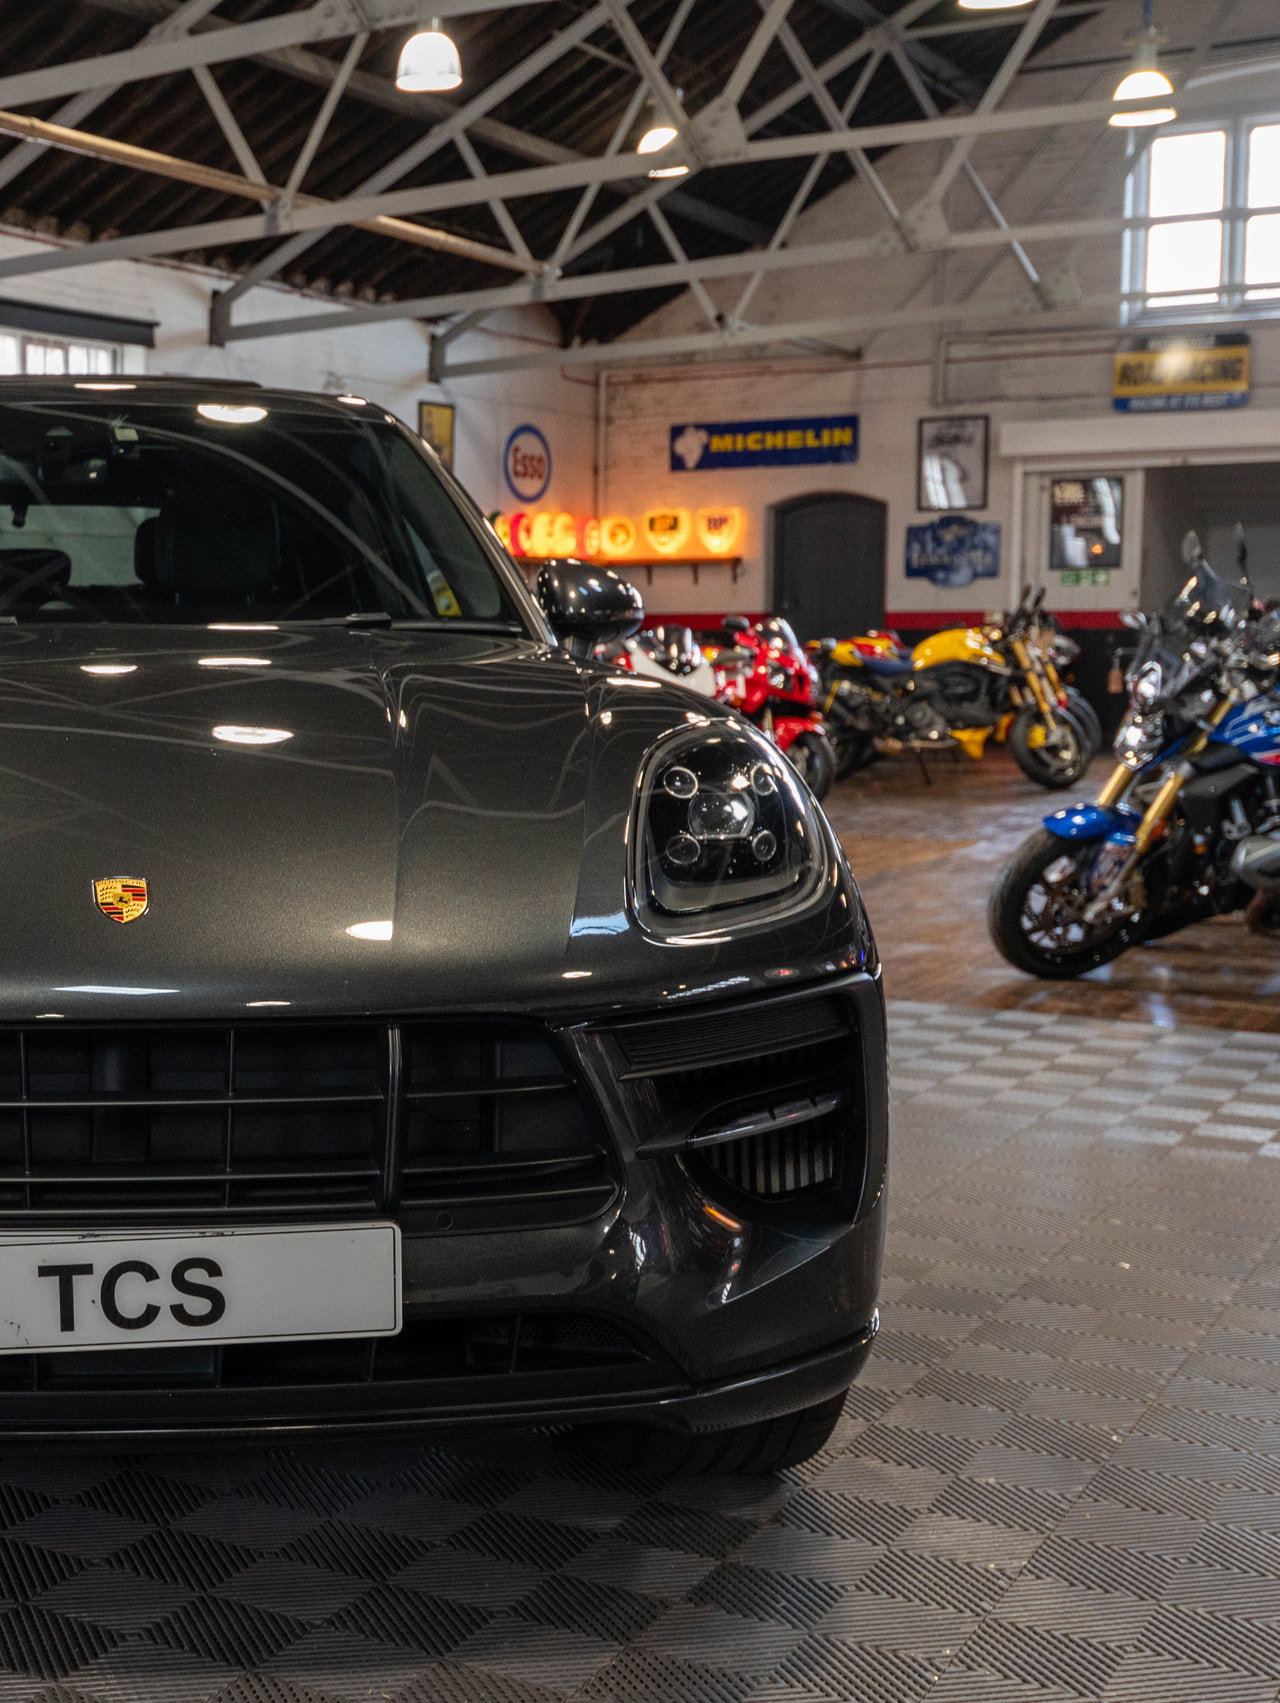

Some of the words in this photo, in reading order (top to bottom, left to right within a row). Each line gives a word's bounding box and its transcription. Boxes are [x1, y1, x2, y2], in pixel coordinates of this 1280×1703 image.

[709, 427, 853, 453] MICHELIN
[512, 446, 546, 479] Esso
[38, 1257, 226, 1332] TCS
